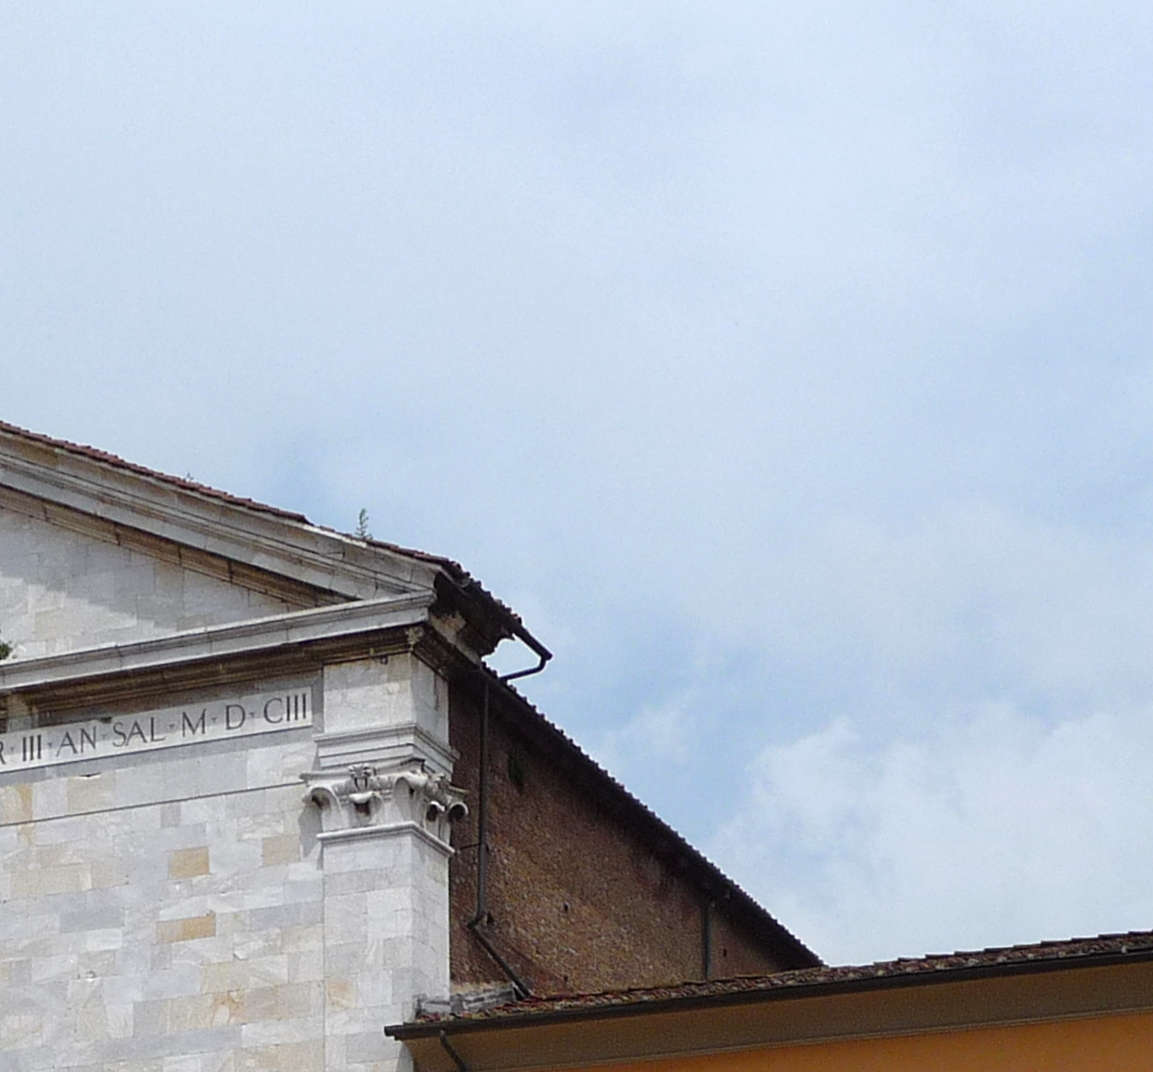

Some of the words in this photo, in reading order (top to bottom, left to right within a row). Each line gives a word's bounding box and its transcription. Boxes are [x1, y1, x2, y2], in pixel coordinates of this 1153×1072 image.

[21, 734, 42, 762] III
[56, 726, 98, 757] AN
[113, 717, 166, 747] SAL
[263, 693, 307, 724] CIII
